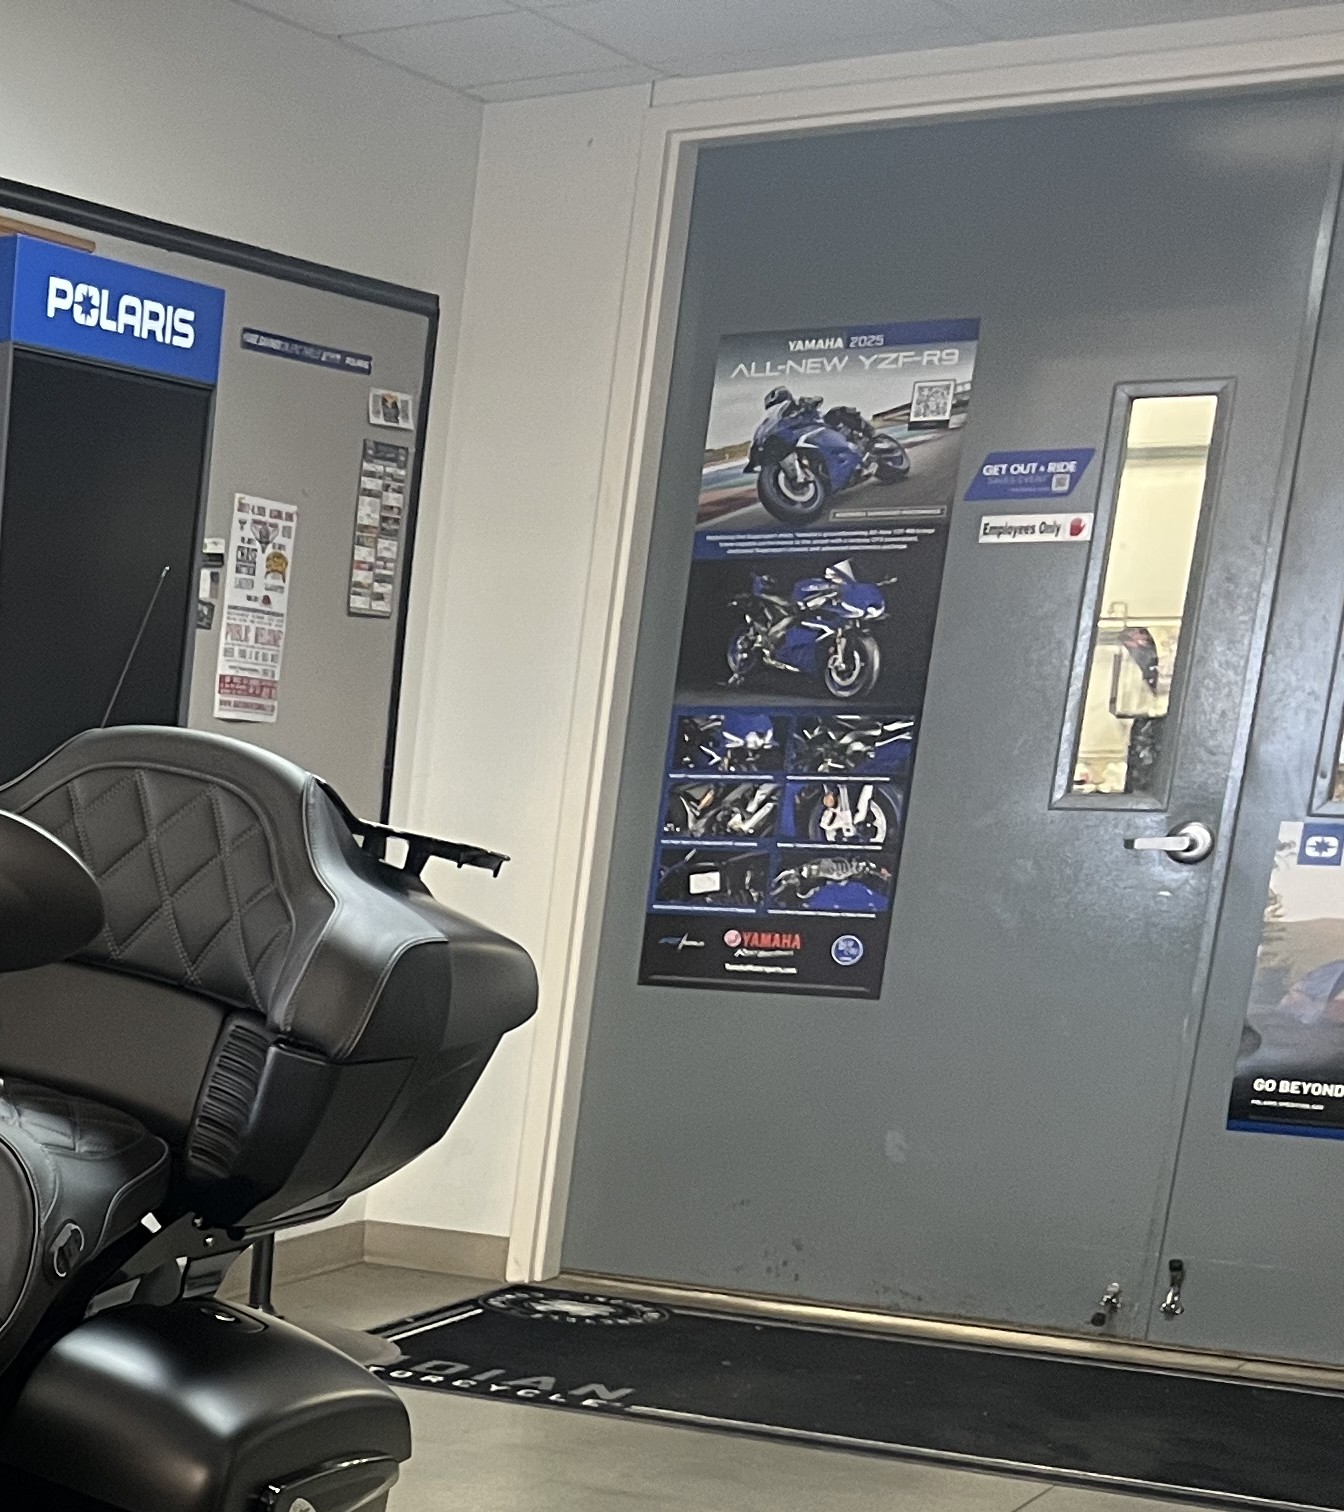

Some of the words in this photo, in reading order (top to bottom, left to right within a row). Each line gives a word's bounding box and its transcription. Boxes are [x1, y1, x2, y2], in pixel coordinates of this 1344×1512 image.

[47, 276, 196, 349] POLARIS
[788, 337, 844, 351] YAMAHA
[849, 335, 885, 348] 2025
[730, 355, 849, 379] ALL-NEW
[859, 349, 960, 370] YZF-R9
[982, 463, 1008, 476] GET
[1010, 462, 1038, 475] OUT
[1047, 461, 1078, 473] RIDE
[983, 522, 1036, 539] Employees
[1039, 521, 1062, 537] Only
[743, 931, 801, 950] YAMAHA
[1253, 1078, 1277, 1092] GO
